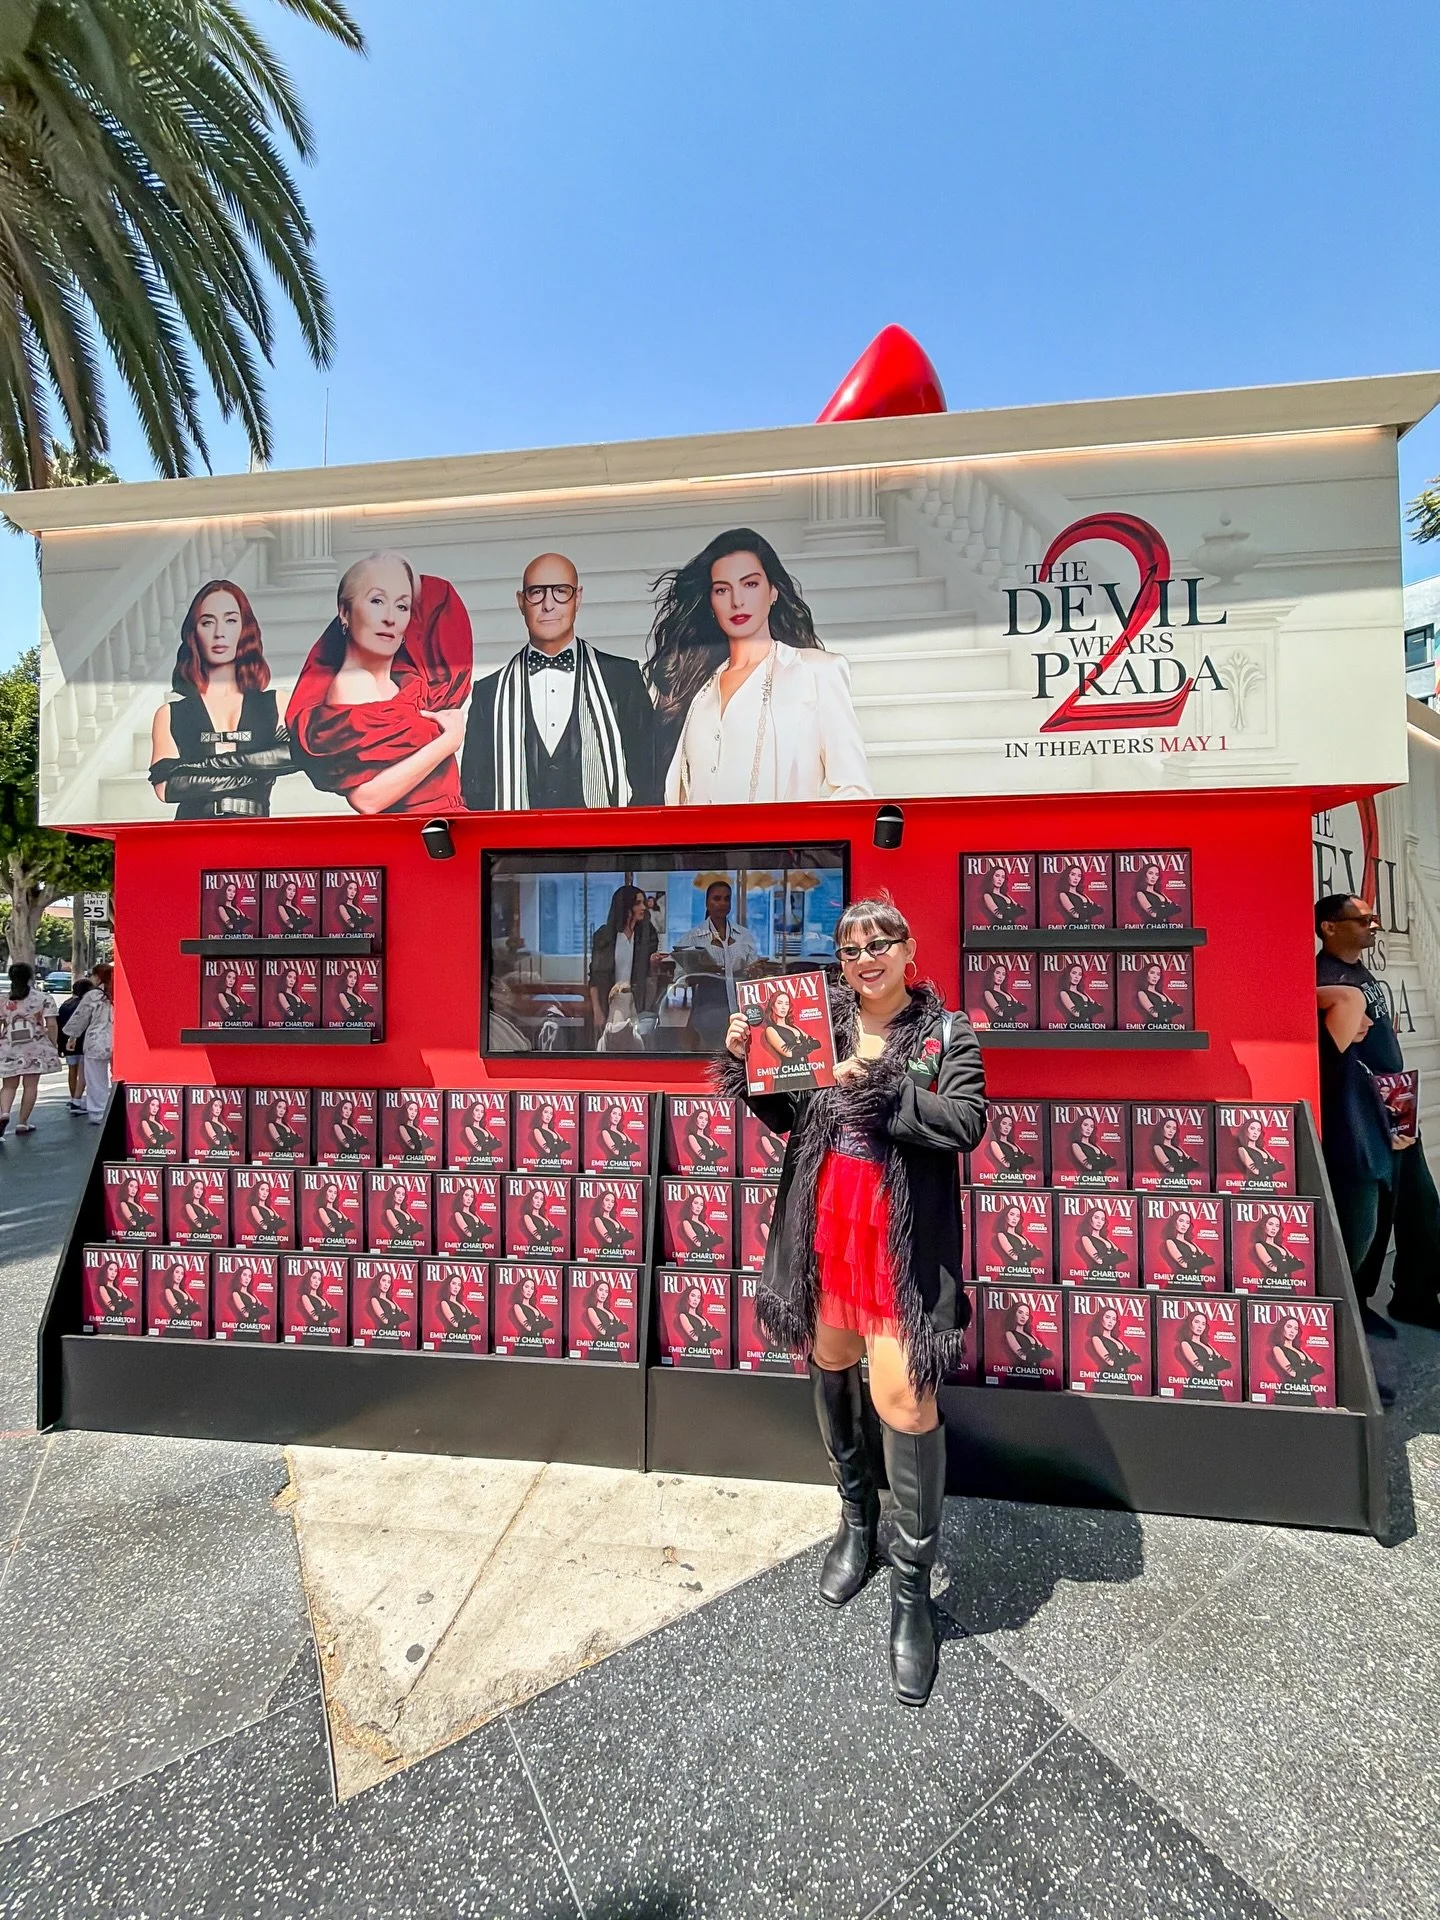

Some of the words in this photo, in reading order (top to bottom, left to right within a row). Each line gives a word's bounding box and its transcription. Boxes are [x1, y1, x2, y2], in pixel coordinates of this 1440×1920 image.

[1025, 561, 1088, 583] THE
[1002, 577, 1227, 636] DEVIL
[1040, 512, 1193, 732] 2
[1069, 632, 1174, 657] WEARS
[1032, 653, 1228, 699] PRADA
[1005, 742, 1029, 758] IN
[1035, 737, 1153, 757] THEATERS
[1160, 735, 1210, 752] MAY
[1219, 735, 1228, 751] 1
[1313, 840, 1409, 934] EVIL
[84, 907, 104, 918] 25
[742, 975, 819, 1005] RUNWAY
[757, 1067, 779, 1076] EMILY
[782, 1062, 825, 1073] CHARLTON
[986, 1106, 1039, 1124] UNWAY
[696, 1165, 729, 1173] CHARLTON
[1082, 1175, 1119, 1183] CHARLTON
[1165, 1178, 1202, 1186] CHARLTON
[1249, 1181, 1287, 1189] CHARLTON
[602, 1248, 635, 1256] CHARLTON
[691, 1252, 725, 1260] CHARLTON
[1008, 1266, 1045, 1275] CHARLTON
[1070, 1269, 1091, 1277] EMILY
[1092, 1270, 1130, 1279] CHARLTON
[1154, 1273, 1175, 1281] EMILY
[1177, 1274, 1216, 1283] CHARLTON
[1243, 1277, 1265, 1285] EMILY
[1267, 1278, 1306, 1287] CHARLTON
[309, 1326, 340, 1334] CHARLTON
[379, 1329, 410, 1337] CHARLTON
[449, 1332, 481, 1341] CHARLTON
[522, 1337, 555, 1345] CHARLTON
[596, 1340, 629, 1349] CHARLTON
[669, 1346, 687, 1354] EMILY
[688, 1347, 723, 1355] CHARLTON
[1016, 1366, 1054, 1376] CHARLTON
[1080, 1371, 1101, 1379] EMILY
[1103, 1372, 1142, 1381] CHARLTON
[1168, 1376, 1191, 1384] EMILY
[1192, 1378, 1233, 1387] CHARLTON
[1260, 1382, 1283, 1391] EMILY
[1285, 1383, 1326, 1393] CHARLTON
